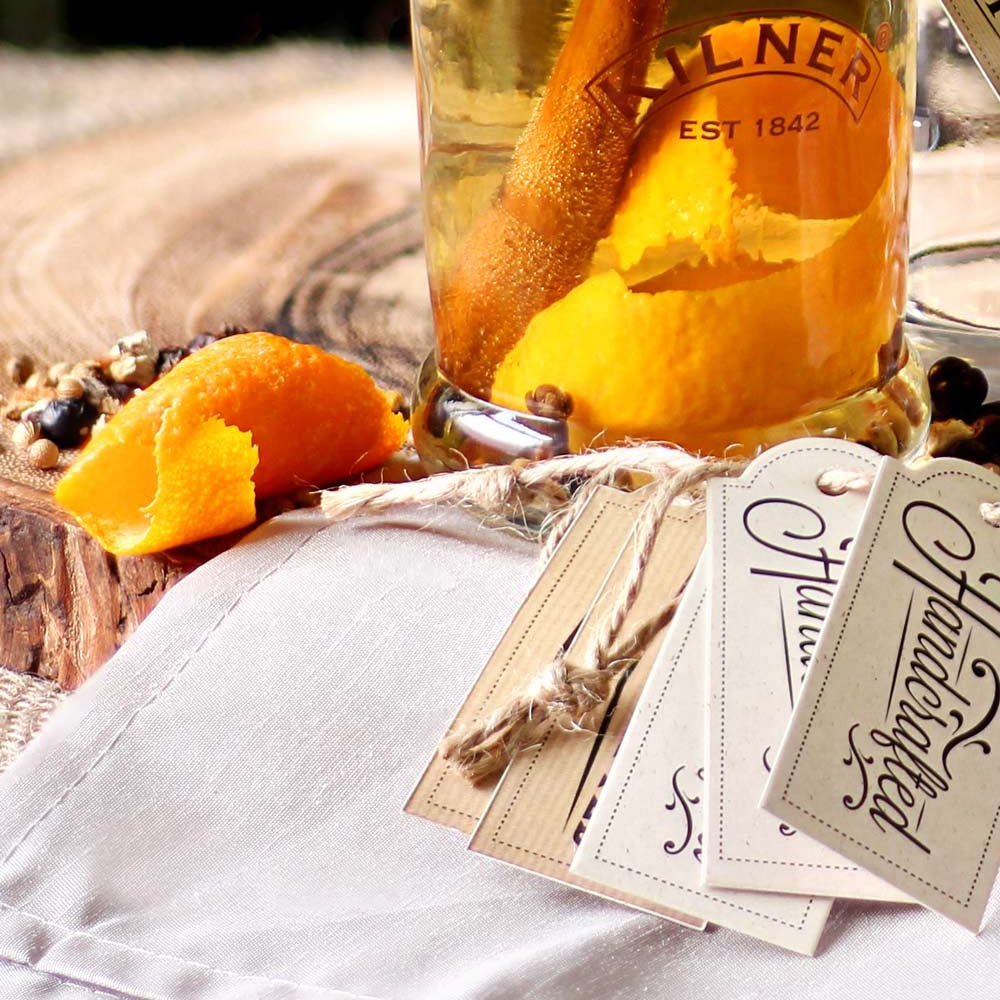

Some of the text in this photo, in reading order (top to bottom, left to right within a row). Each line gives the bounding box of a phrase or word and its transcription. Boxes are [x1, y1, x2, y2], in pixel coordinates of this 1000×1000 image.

[597, 23, 872, 121] KILNER
[679, 111, 820, 140] EST 1842
